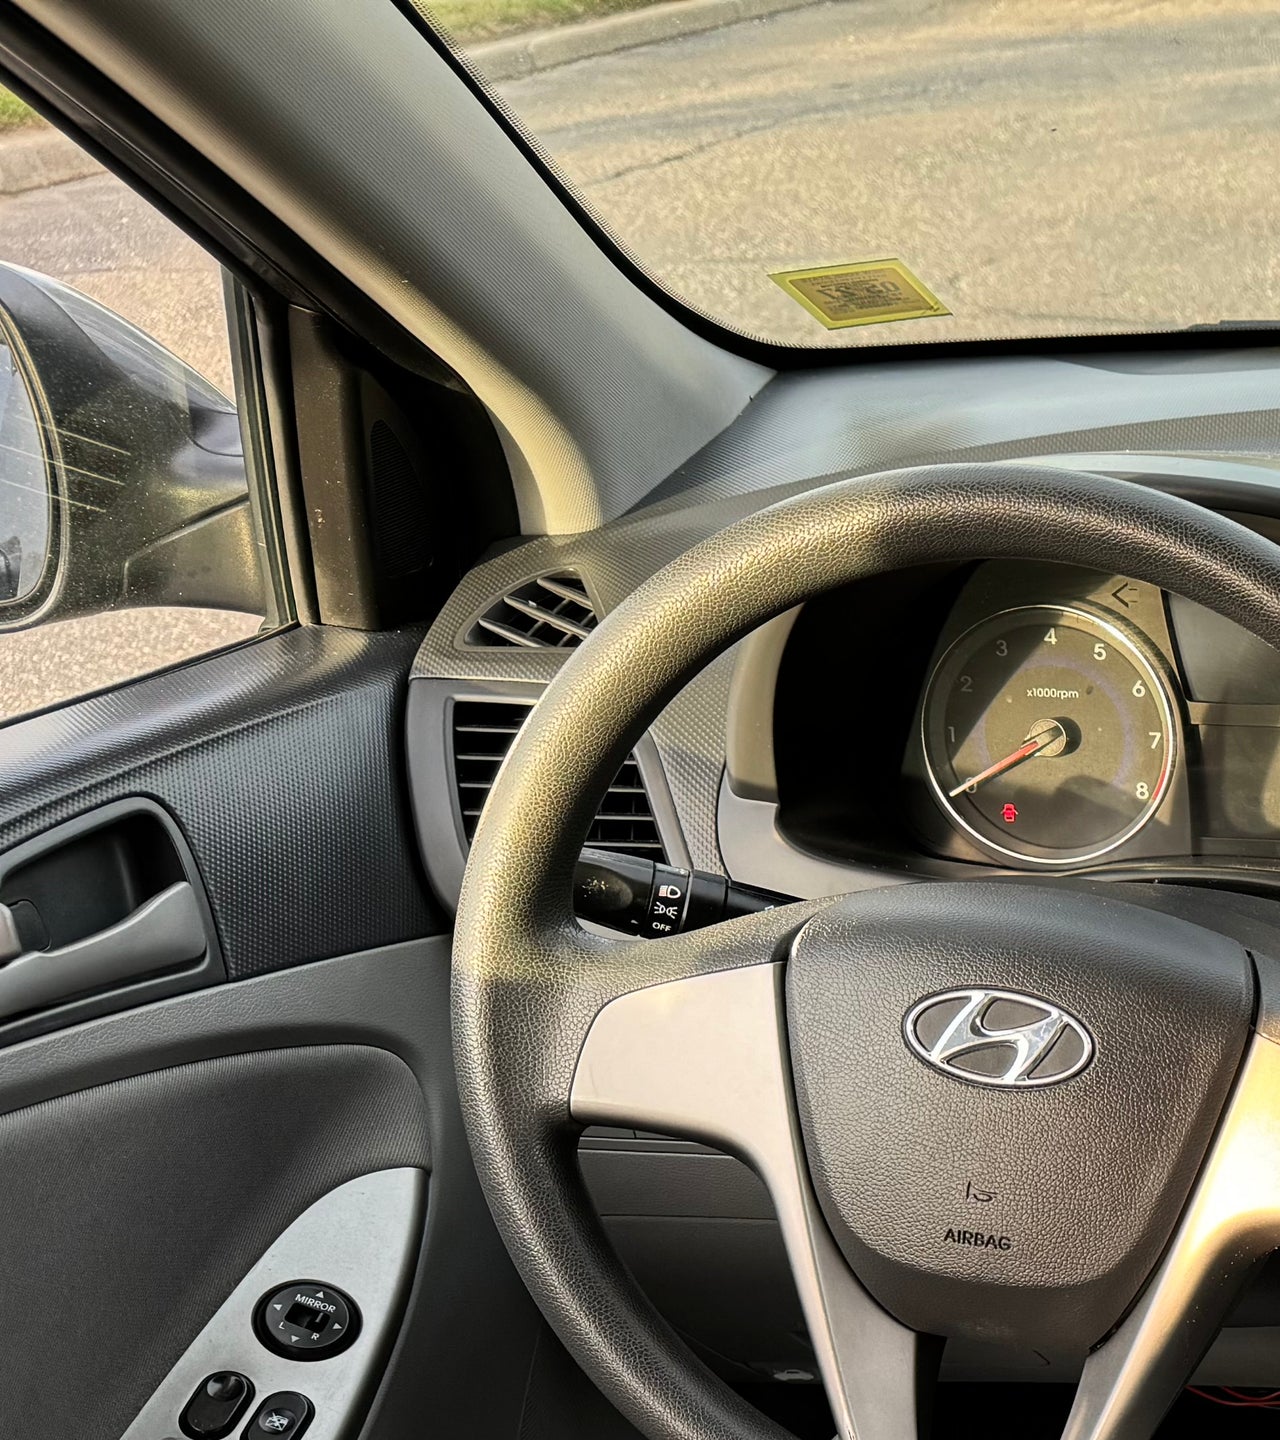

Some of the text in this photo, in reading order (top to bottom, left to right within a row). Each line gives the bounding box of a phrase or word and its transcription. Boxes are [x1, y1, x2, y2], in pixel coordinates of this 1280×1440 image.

[1043, 628, 1057, 645] 4
[996, 640, 1008, 656] 3
[1093, 643, 1107, 661] 5
[960, 675, 973, 692] 2
[1132, 680, 1146, 697] 6
[1026, 688, 1080, 700] x1000rpm
[948, 727, 955, 743] 1
[1148, 731, 1161, 750] 7
[1135, 781, 1149, 800] 8
[652, 921, 672, 932] OFF
[943, 1228, 1012, 1251] AIRBAG
[295, 1293, 337, 1313] MIRROR
[278, 1321, 285, 1330] L
[310, 1332, 320, 1341] R
